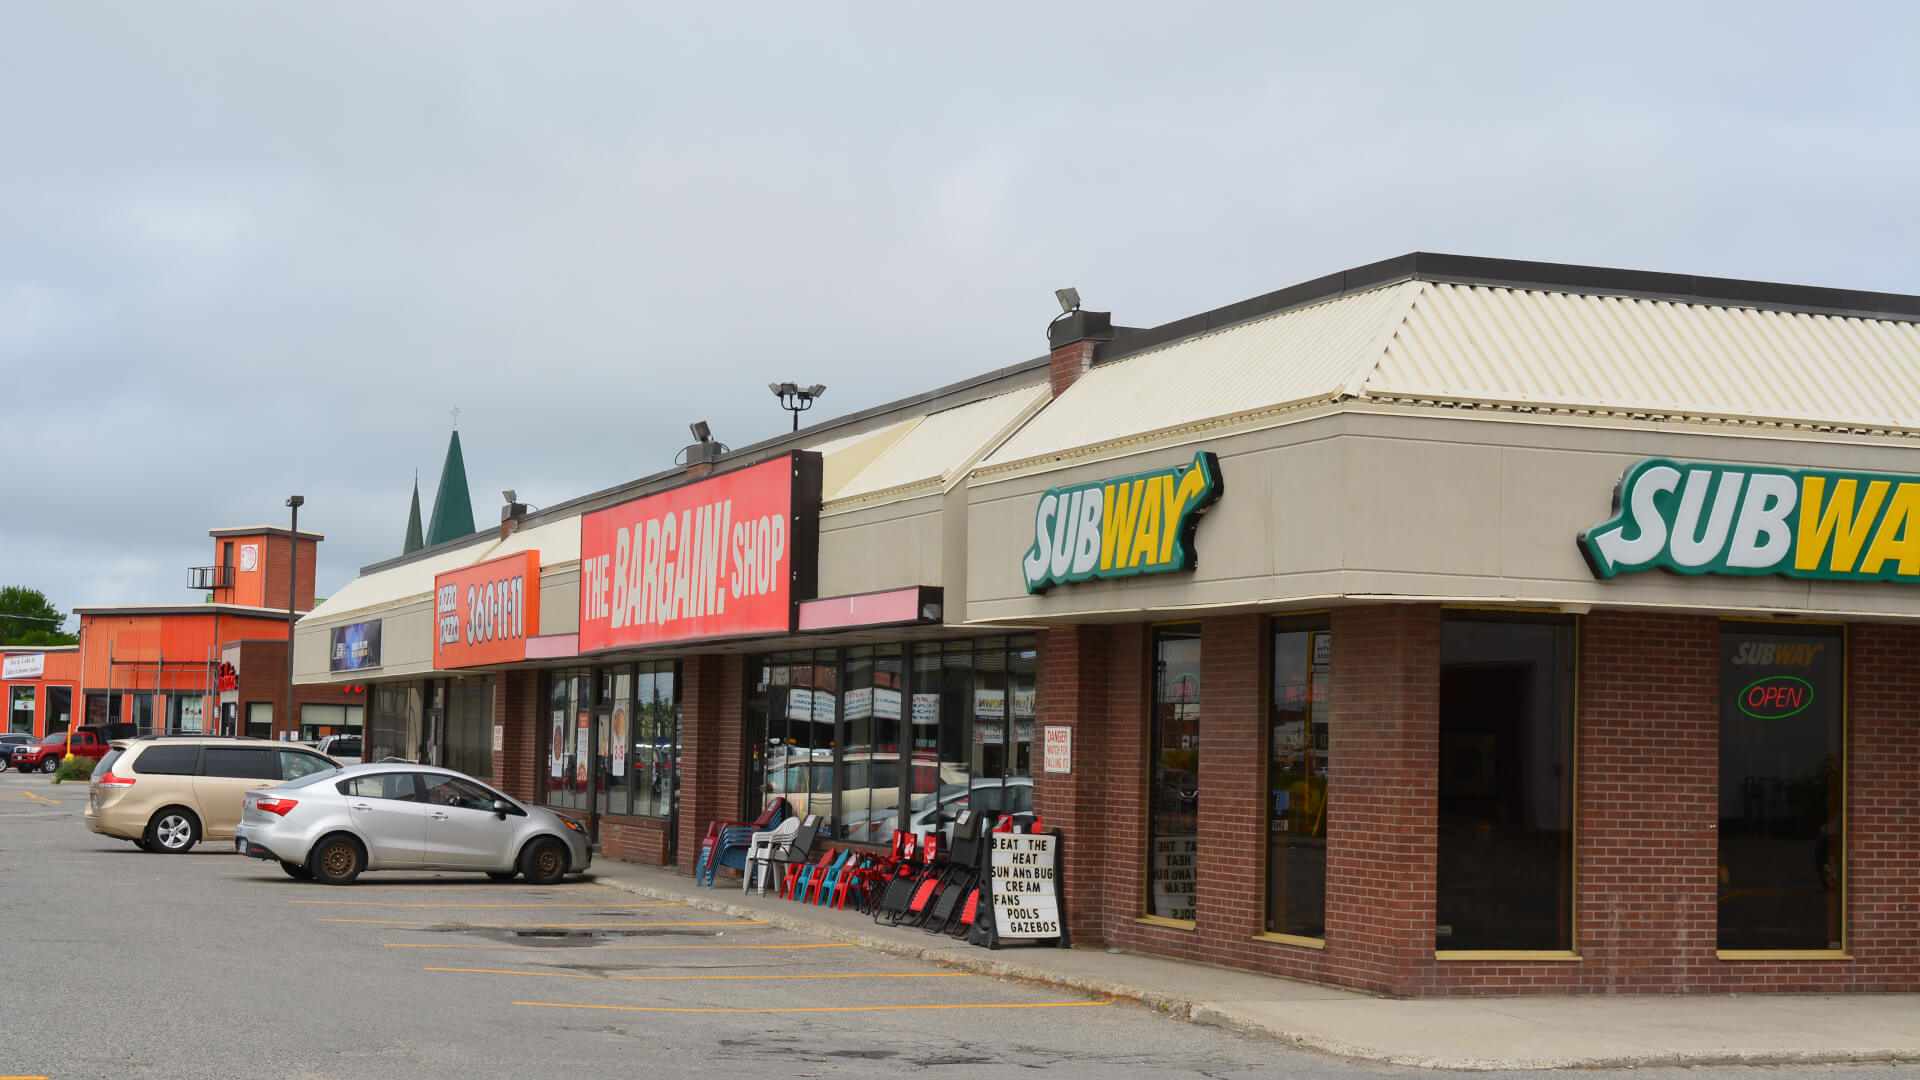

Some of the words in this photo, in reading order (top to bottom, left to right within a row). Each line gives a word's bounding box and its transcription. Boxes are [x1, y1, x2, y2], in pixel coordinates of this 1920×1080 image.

[1023, 460, 1205, 586] SUBWAY
[1595, 466, 1920, 576] SUBWA
[584, 553, 610, 621] THE
[611, 499, 732, 629] BARGAIN!
[731, 513, 785, 599] SHOP
[1732, 642, 1824, 665] SUBWAY
[1748, 686, 1803, 707] OPEN
[1047, 730, 1068, 743] DANGER
[1047, 744, 1060, 755] WATCH
[1046, 757, 1062, 768] FALLING
[914, 768, 936, 793] BIG
[992, 838, 1019, 850] BEAT
[1029, 840, 1047, 851] THE
[1012, 853, 1038, 864] HEAT
[992, 866, 1009, 878] SUN
[1013, 867, 1032, 878] AND
[1034, 868, 1053, 879] BUG
[1005, 881, 1041, 892] CREAM
[994, 894, 1020, 906] FANS
[1007, 908, 1039, 919] POOLS
[1010, 922, 1057, 933] GAZEBOS
